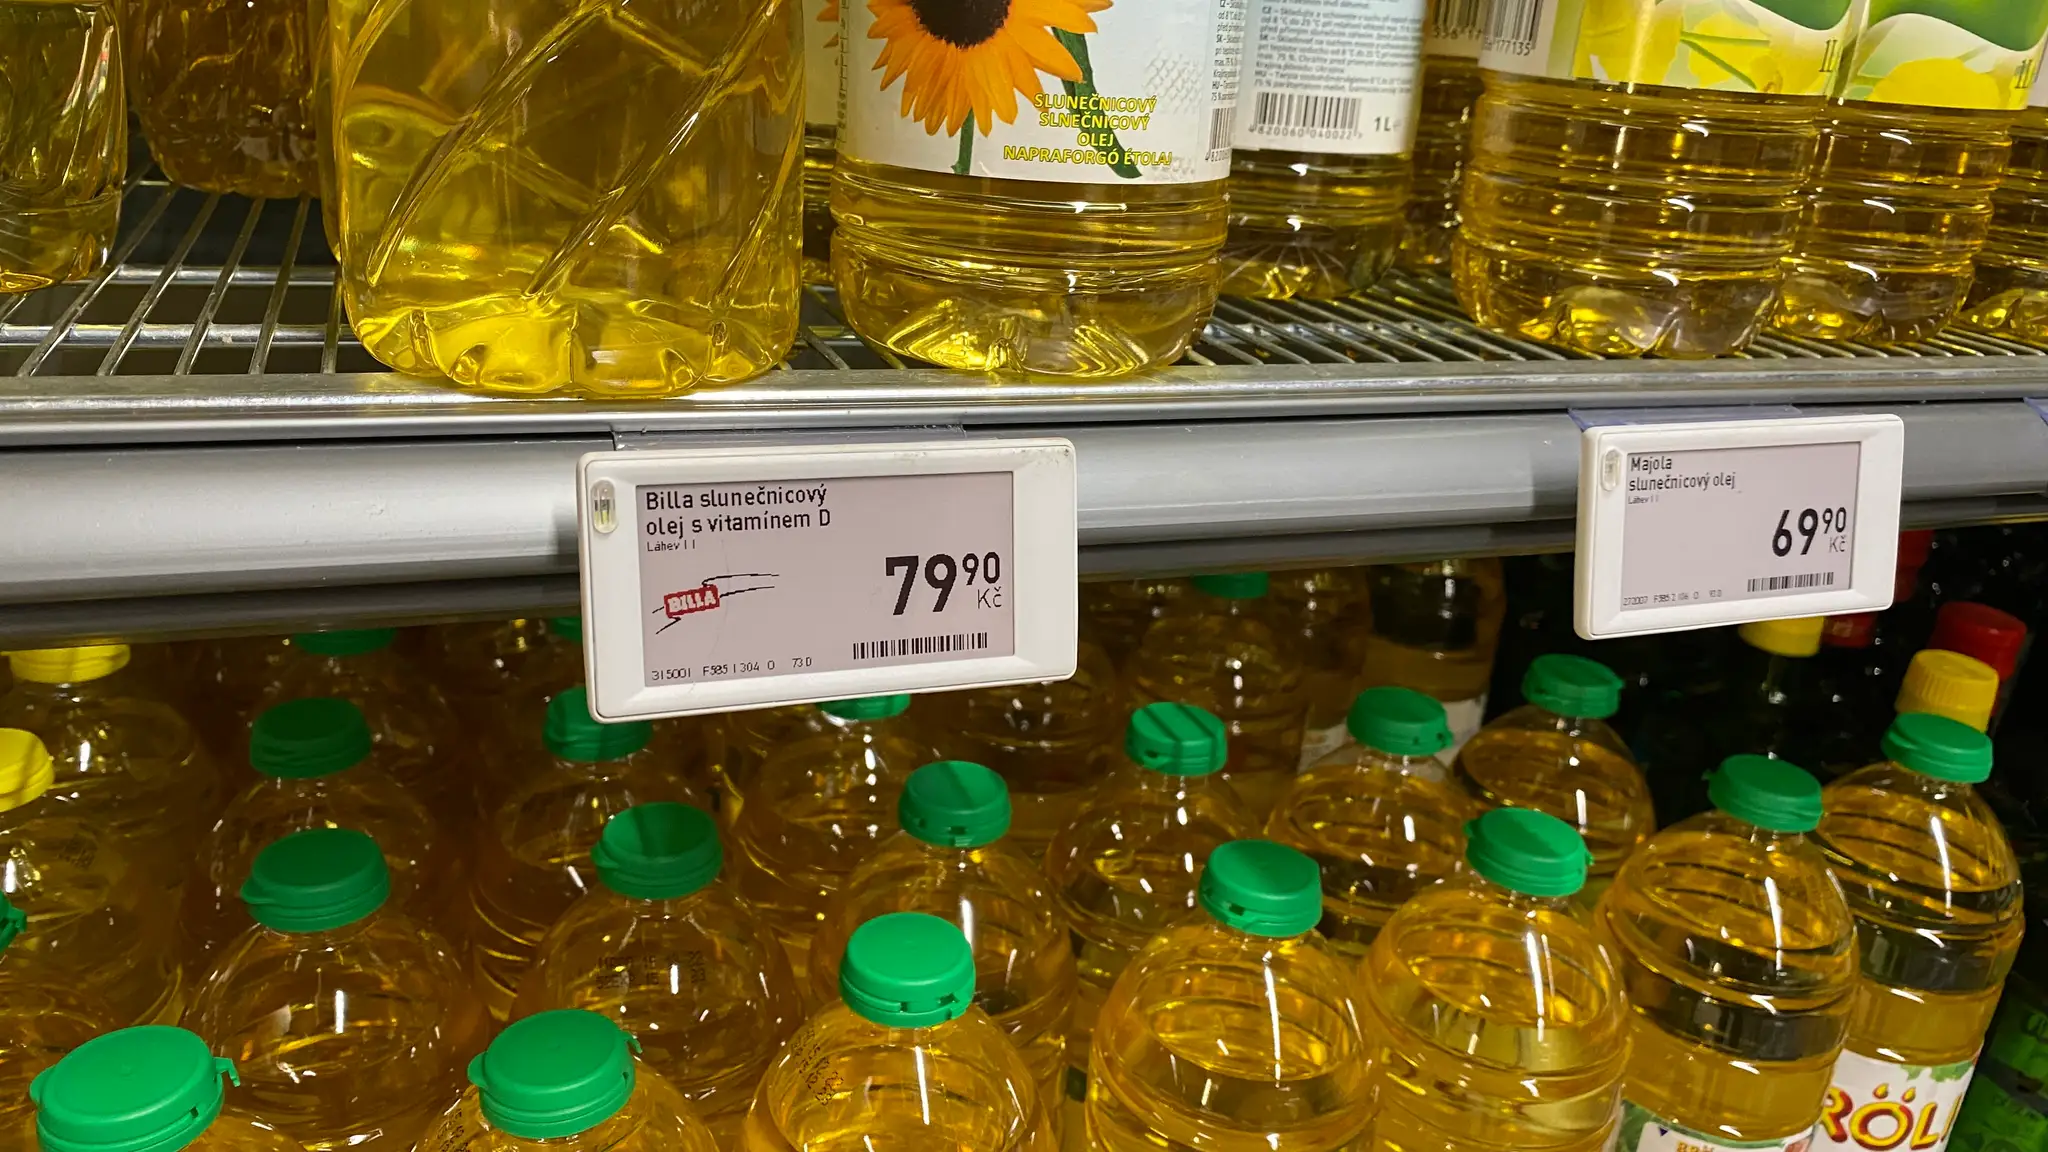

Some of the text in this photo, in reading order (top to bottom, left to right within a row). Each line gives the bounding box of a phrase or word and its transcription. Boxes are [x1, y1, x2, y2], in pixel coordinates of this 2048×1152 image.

[1034, 93, 1157, 113] SLUNEČNICOVÝ
[1039, 112, 1150, 130] SLNEČNICOVÝ
[1077, 132, 1113, 147] OLEJ
[1003, 145, 1172, 166] NAPRAFORGÓ ÉTOLAJ
[1630, 456, 1673, 474] Majola
[1629, 472, 1735, 492] slunečnicový olej
[646, 483, 828, 510] Billa slunečnicový
[646, 509, 831, 539] olej s vitamínem D
[1772, 507, 1846, 557] 69 90
[647, 541, 680, 552] Láhev
[1829, 535, 1847, 553] Kč
[886, 551, 1001, 616] 79 90
[667, 590, 717, 613] BILLA
[977, 587, 1003, 610] Kč
